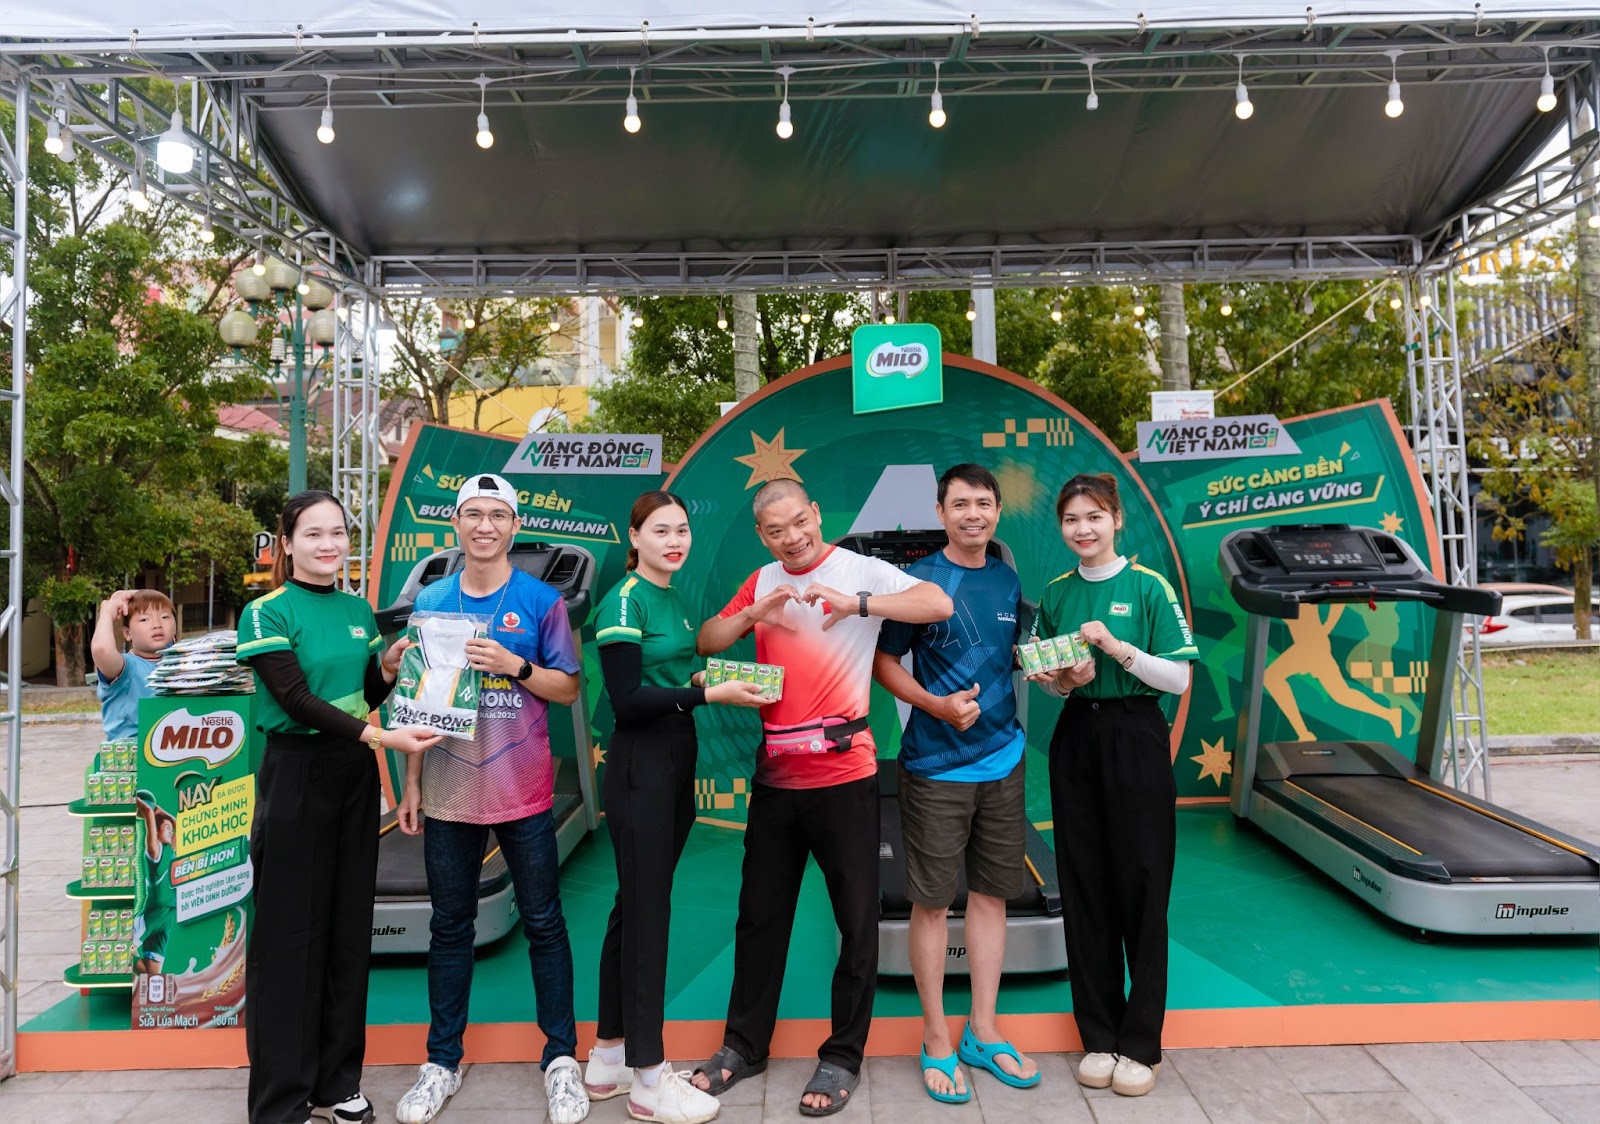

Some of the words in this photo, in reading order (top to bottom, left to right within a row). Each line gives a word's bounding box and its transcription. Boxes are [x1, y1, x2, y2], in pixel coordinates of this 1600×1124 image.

[876, 352, 922, 367] MILO
[1155, 437, 1200, 455] VIỆT
[1204, 437, 1248, 452] NAM
[530, 452, 575, 469] VIỆT
[577, 454, 622, 468] NAM
[1207, 475, 1246, 496] SỨC
[1248, 466, 1301, 488] CÀNG
[1304, 455, 1343, 479] BỀN
[437, 474, 466, 491] SỨ
[531, 489, 572, 513] BỀN
[1199, 501, 1212, 518] Ý
[1215, 495, 1249, 516] CHÍ
[1252, 490, 1304, 510] CÀNG
[1308, 481, 1363, 503] VỮNG
[419, 504, 456, 518] BƯỚ
[521, 512, 551, 528] ÀNG
[551, 519, 609, 535] NHANH
[202, 716, 235, 726] Nestlé
[497, 711, 516, 719] 2025
[160, 725, 234, 750] MILO
[178, 778, 217, 812] NAY
[182, 807, 218, 828] CHỨNG
[221, 797, 248, 815] MINH
[183, 822, 219, 846] KHOA
[221, 811, 248, 833] HỌC
[205, 891, 220, 903] DINH
[1516, 905, 1569, 918] impulse
[156, 1014, 172, 1027] Lúa
[174, 1014, 198, 1030] Mạch
[227, 1013, 238, 1026] ml
